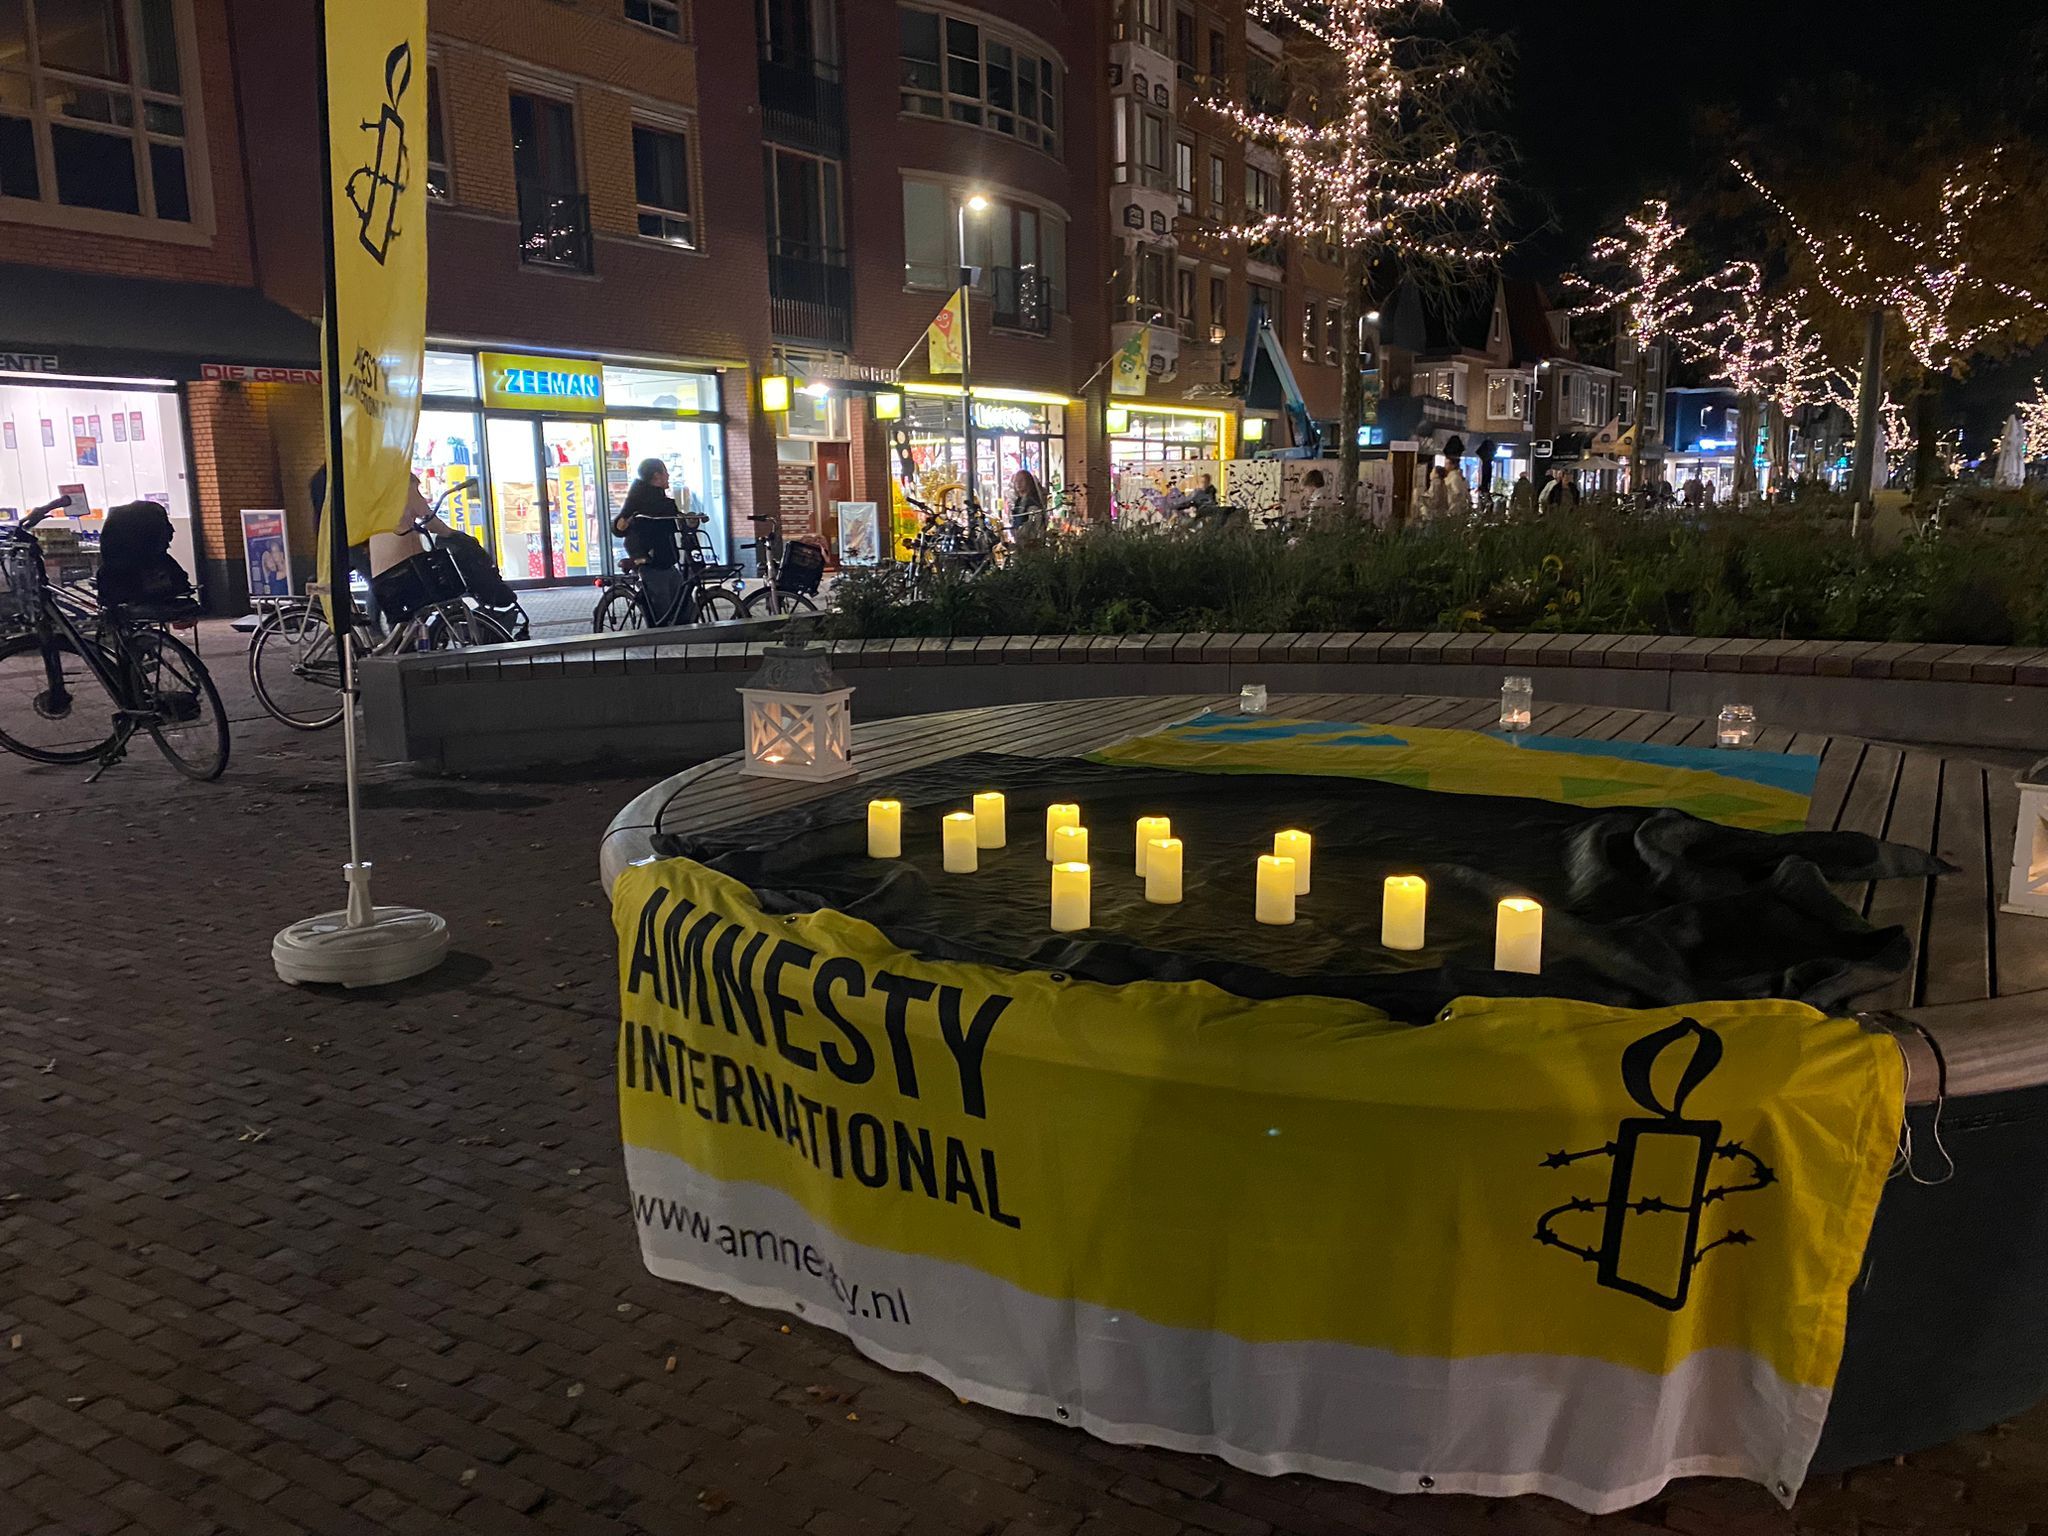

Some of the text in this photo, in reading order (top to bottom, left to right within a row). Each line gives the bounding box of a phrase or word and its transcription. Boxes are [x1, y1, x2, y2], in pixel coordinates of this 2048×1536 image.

[202, 365, 245, 380] DIE
[502, 367, 599, 399] ZEEMAN
[564, 480, 580, 553] ZEEMAN
[627, 886, 1014, 1120] AMNESTY
[625, 1020, 1021, 1230] INTERNATIONAL
